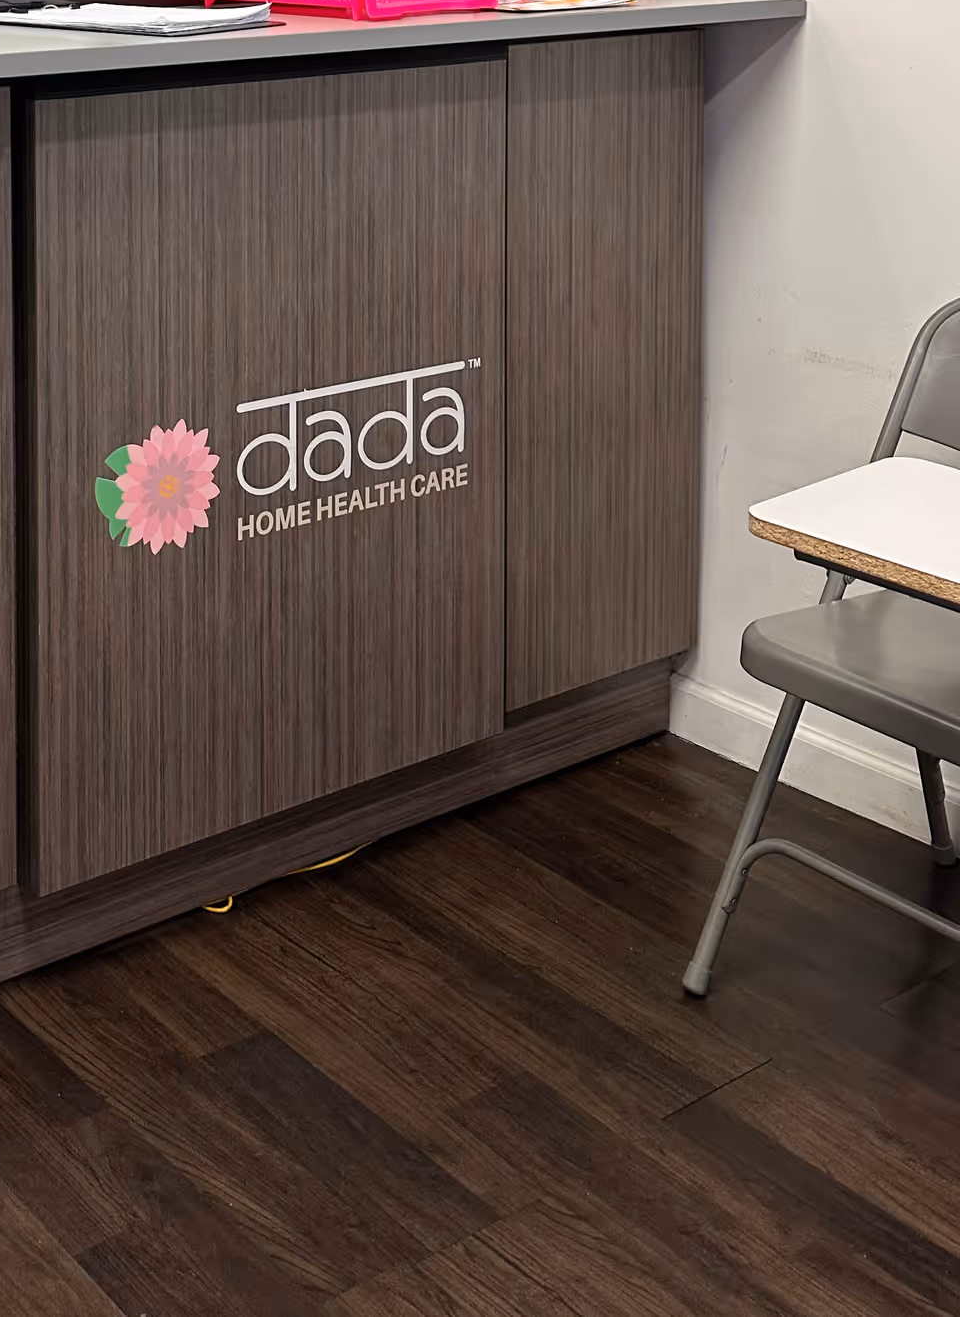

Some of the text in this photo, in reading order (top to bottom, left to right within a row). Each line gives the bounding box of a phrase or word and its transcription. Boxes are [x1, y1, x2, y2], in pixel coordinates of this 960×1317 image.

[236, 357, 482, 496] dada TM
[237, 463, 469, 541] HOME HEALTH CARE
